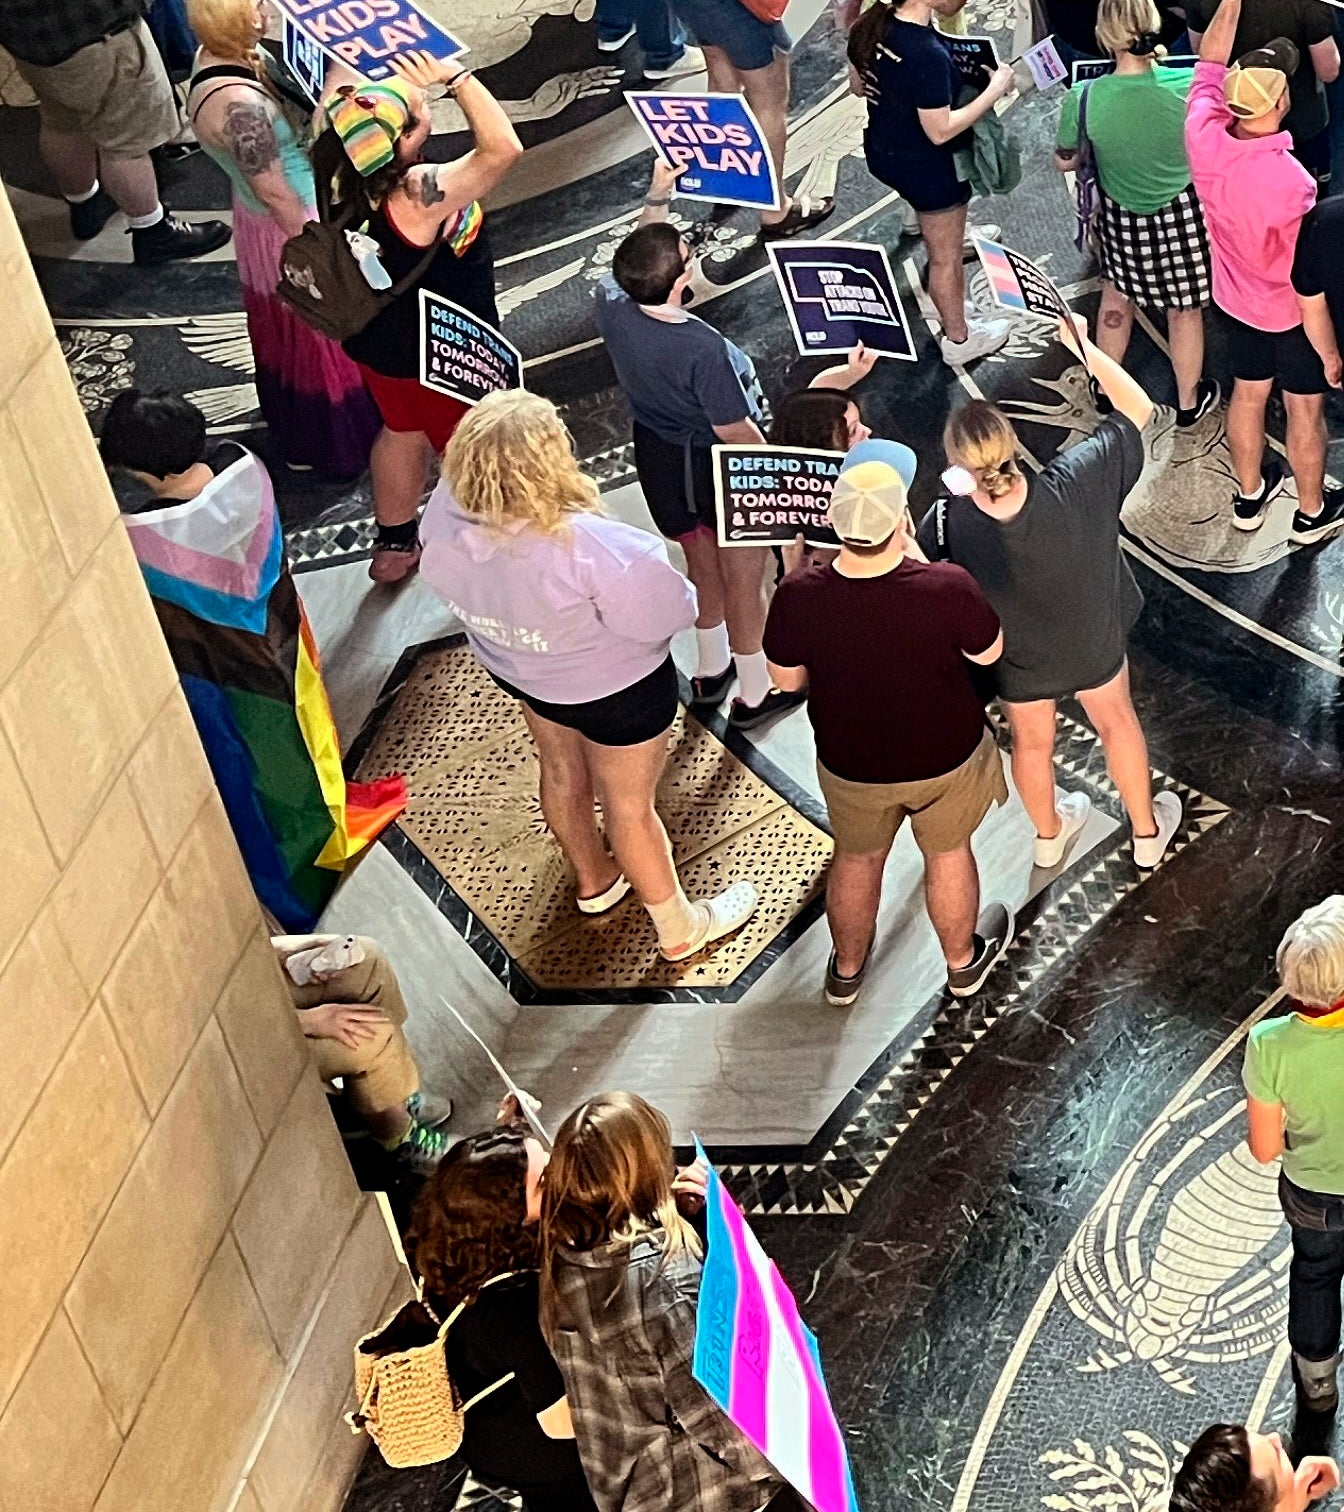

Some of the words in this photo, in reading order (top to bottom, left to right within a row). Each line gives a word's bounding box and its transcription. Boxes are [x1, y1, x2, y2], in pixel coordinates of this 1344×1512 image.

[334, 13, 430, 64] PLAY
[638, 100, 709, 121] LET
[652, 124, 753, 147] KIDS
[668, 147, 762, 176] PLAY
[728, 457, 801, 474] DEFEND
[730, 476, 780, 490] KIDS:
[732, 512, 745, 526] &
